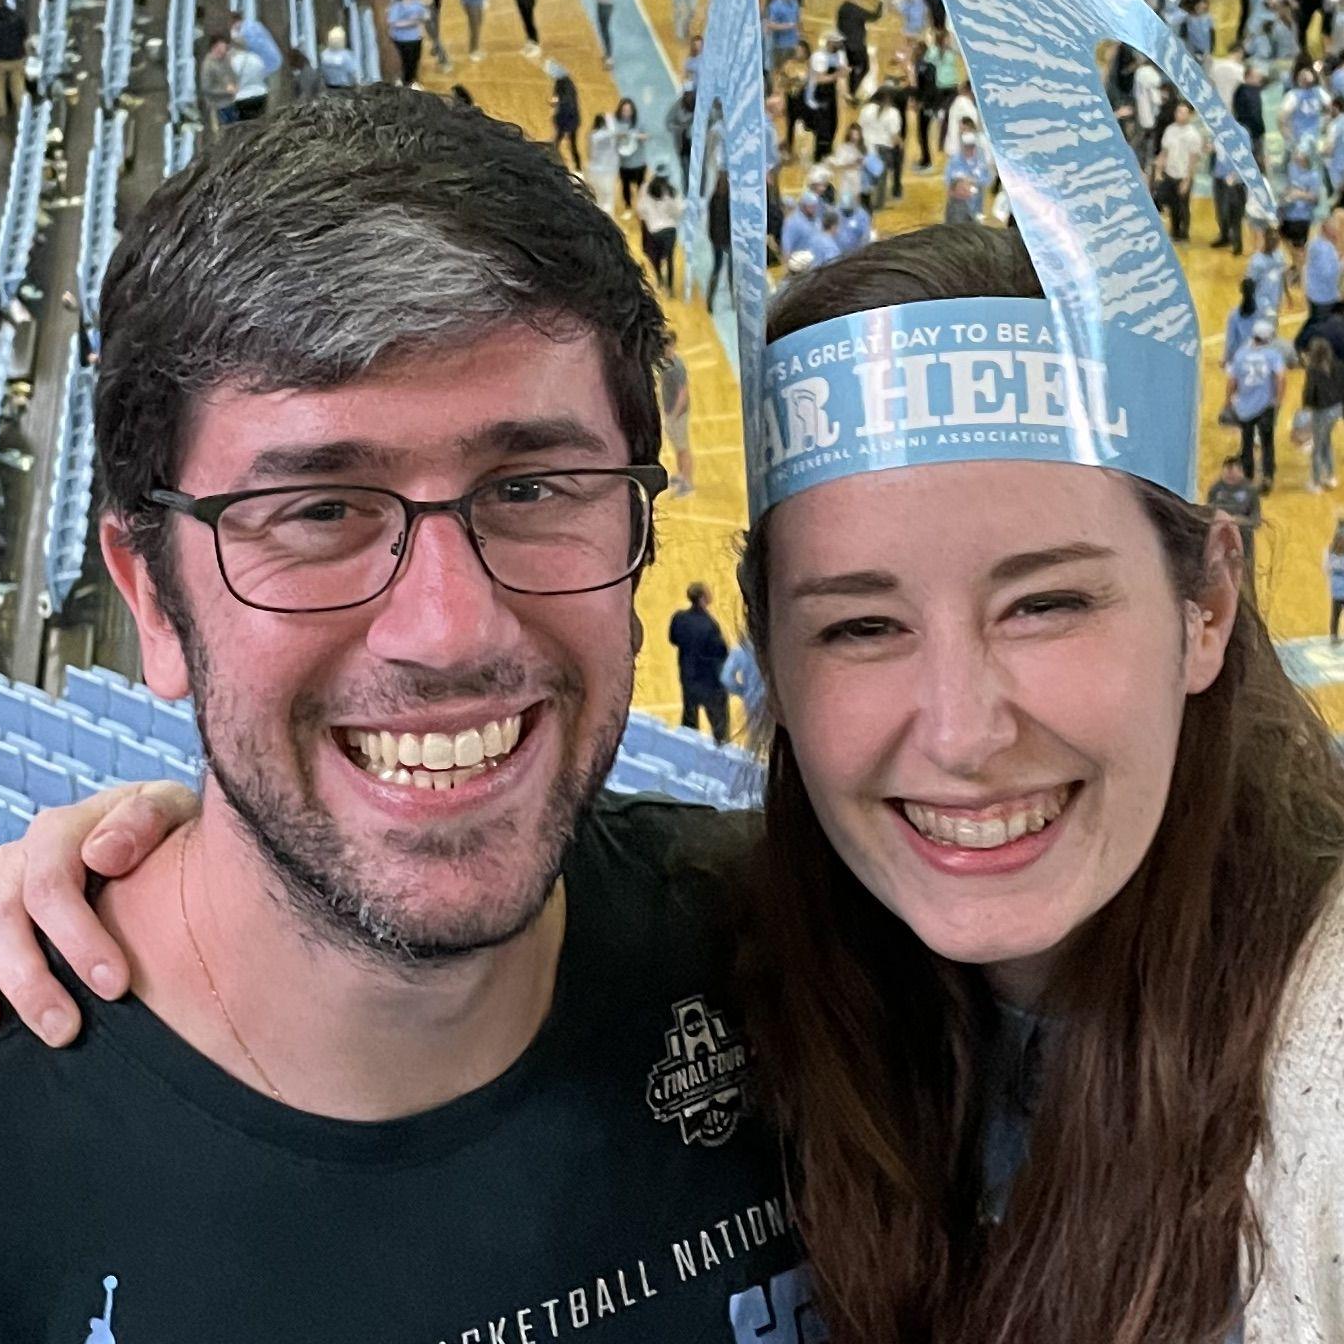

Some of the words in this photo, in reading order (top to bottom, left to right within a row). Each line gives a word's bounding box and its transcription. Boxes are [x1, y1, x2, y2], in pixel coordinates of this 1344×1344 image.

[791, 355, 804, 375] A
[807, 333, 881, 368] GREAT
[891, 325, 941, 350] DAY
[950, 323, 988, 344] TO
[997, 323, 1030, 344] BE
[1037, 326, 1054, 346] A
[759, 376, 840, 468] AR
[852, 350, 1128, 438] HEEL
[859, 433, 927, 456] ALUMNI
[937, 429, 1060, 446] ASSOCIATION
[663, 1060, 709, 1100] FINAL
[708, 1044, 746, 1078] FOUR
